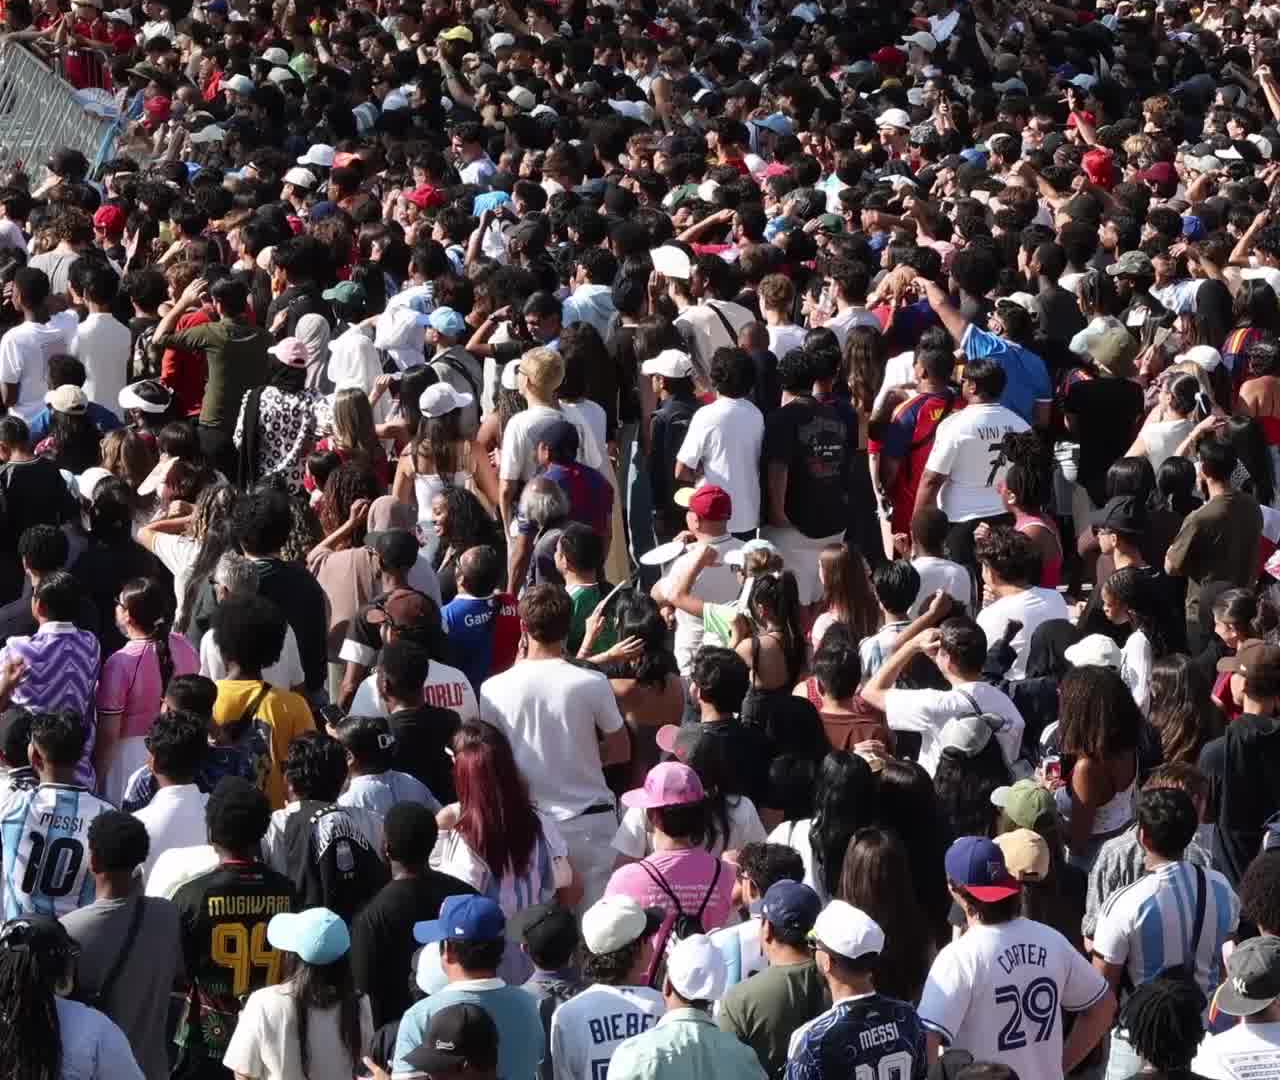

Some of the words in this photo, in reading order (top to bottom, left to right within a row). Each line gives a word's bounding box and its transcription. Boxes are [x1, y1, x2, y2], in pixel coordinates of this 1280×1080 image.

[424, 682, 464, 708] ORLD
[40, 812, 84, 832] MESSI
[22, 831, 84, 897] 10
[997, 943, 1048, 975] CARTER
[588, 1012, 661, 1045] BIEBE
[995, 976, 1059, 1052] 29
[859, 1022, 900, 1051] MESSI
